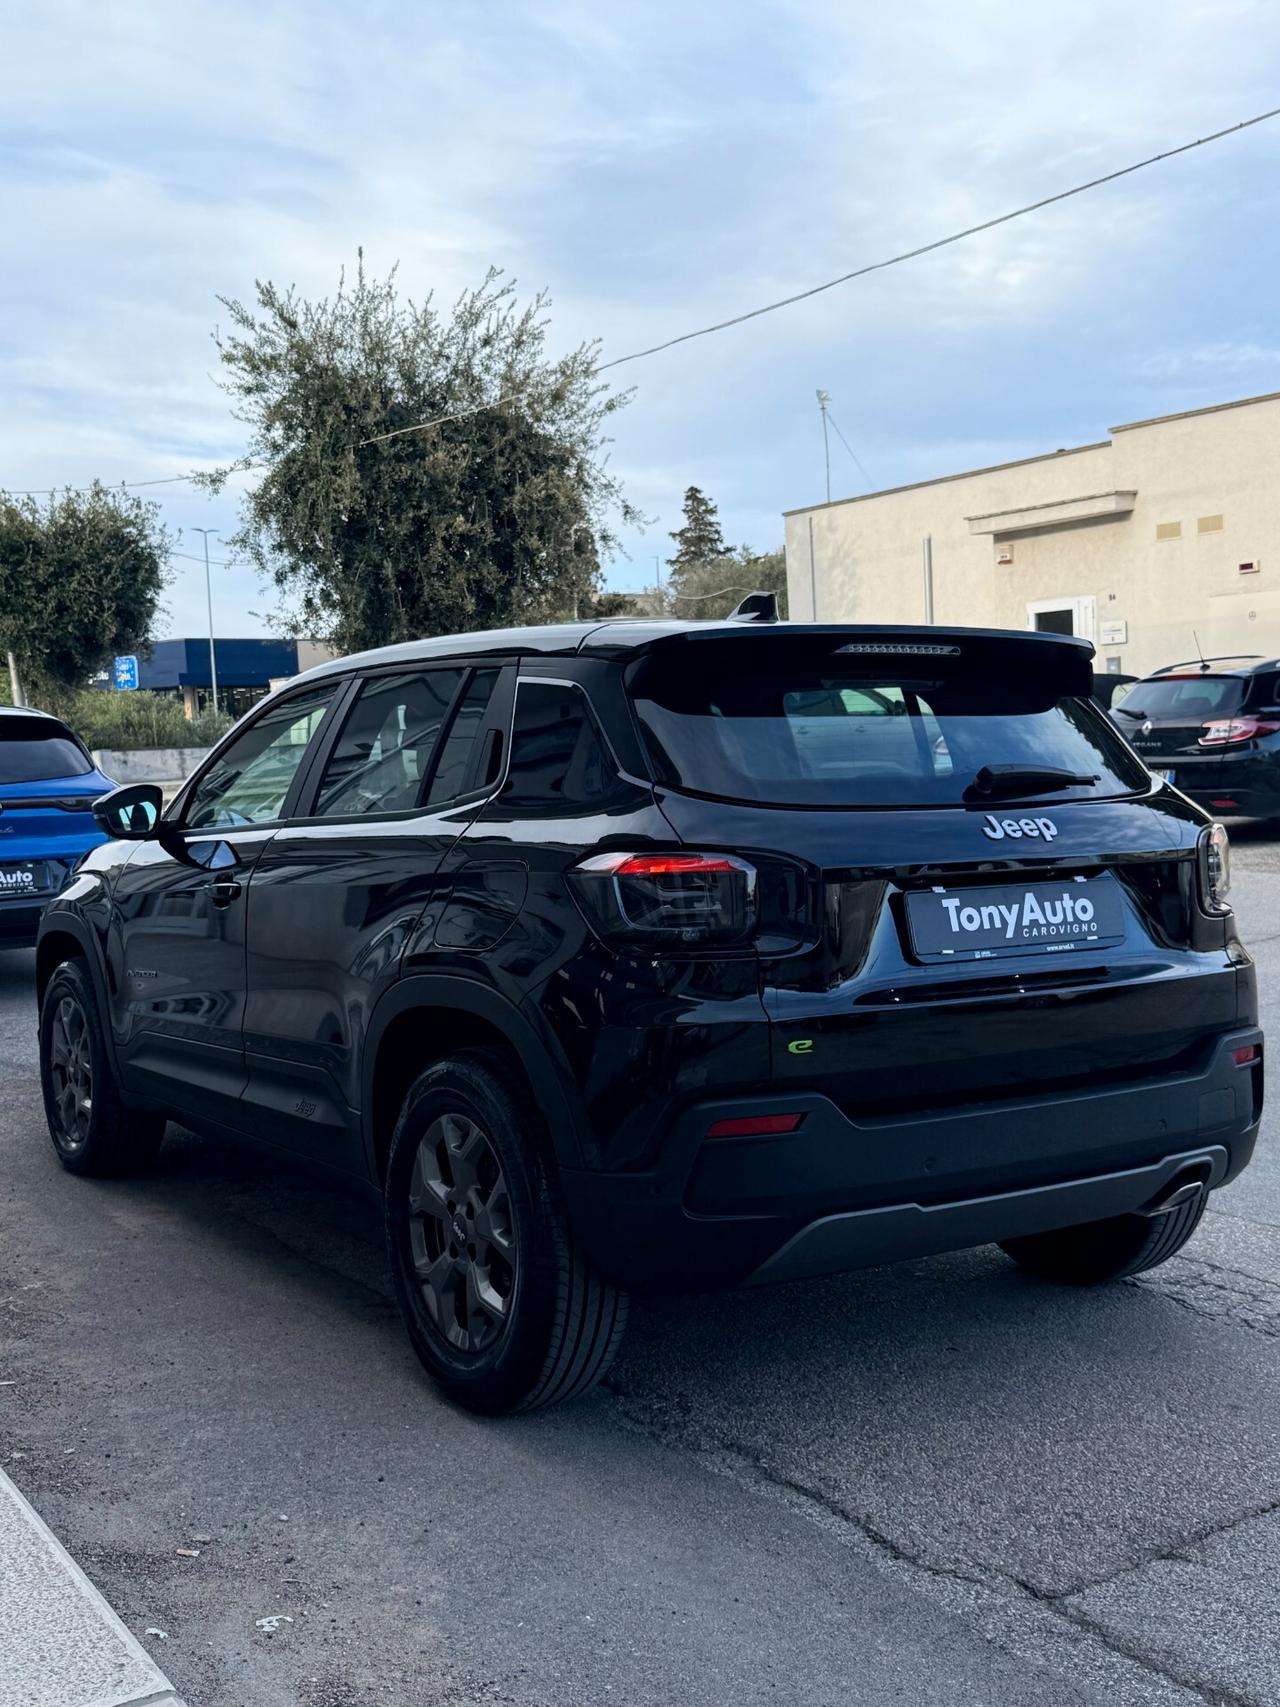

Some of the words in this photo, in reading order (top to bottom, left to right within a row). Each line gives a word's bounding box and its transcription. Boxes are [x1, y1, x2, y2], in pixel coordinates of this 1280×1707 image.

[982, 815, 1058, 841] Jeep
[942, 892, 1094, 939] TonyAuto
[1023, 922, 1098, 938] CAROVIGNO
